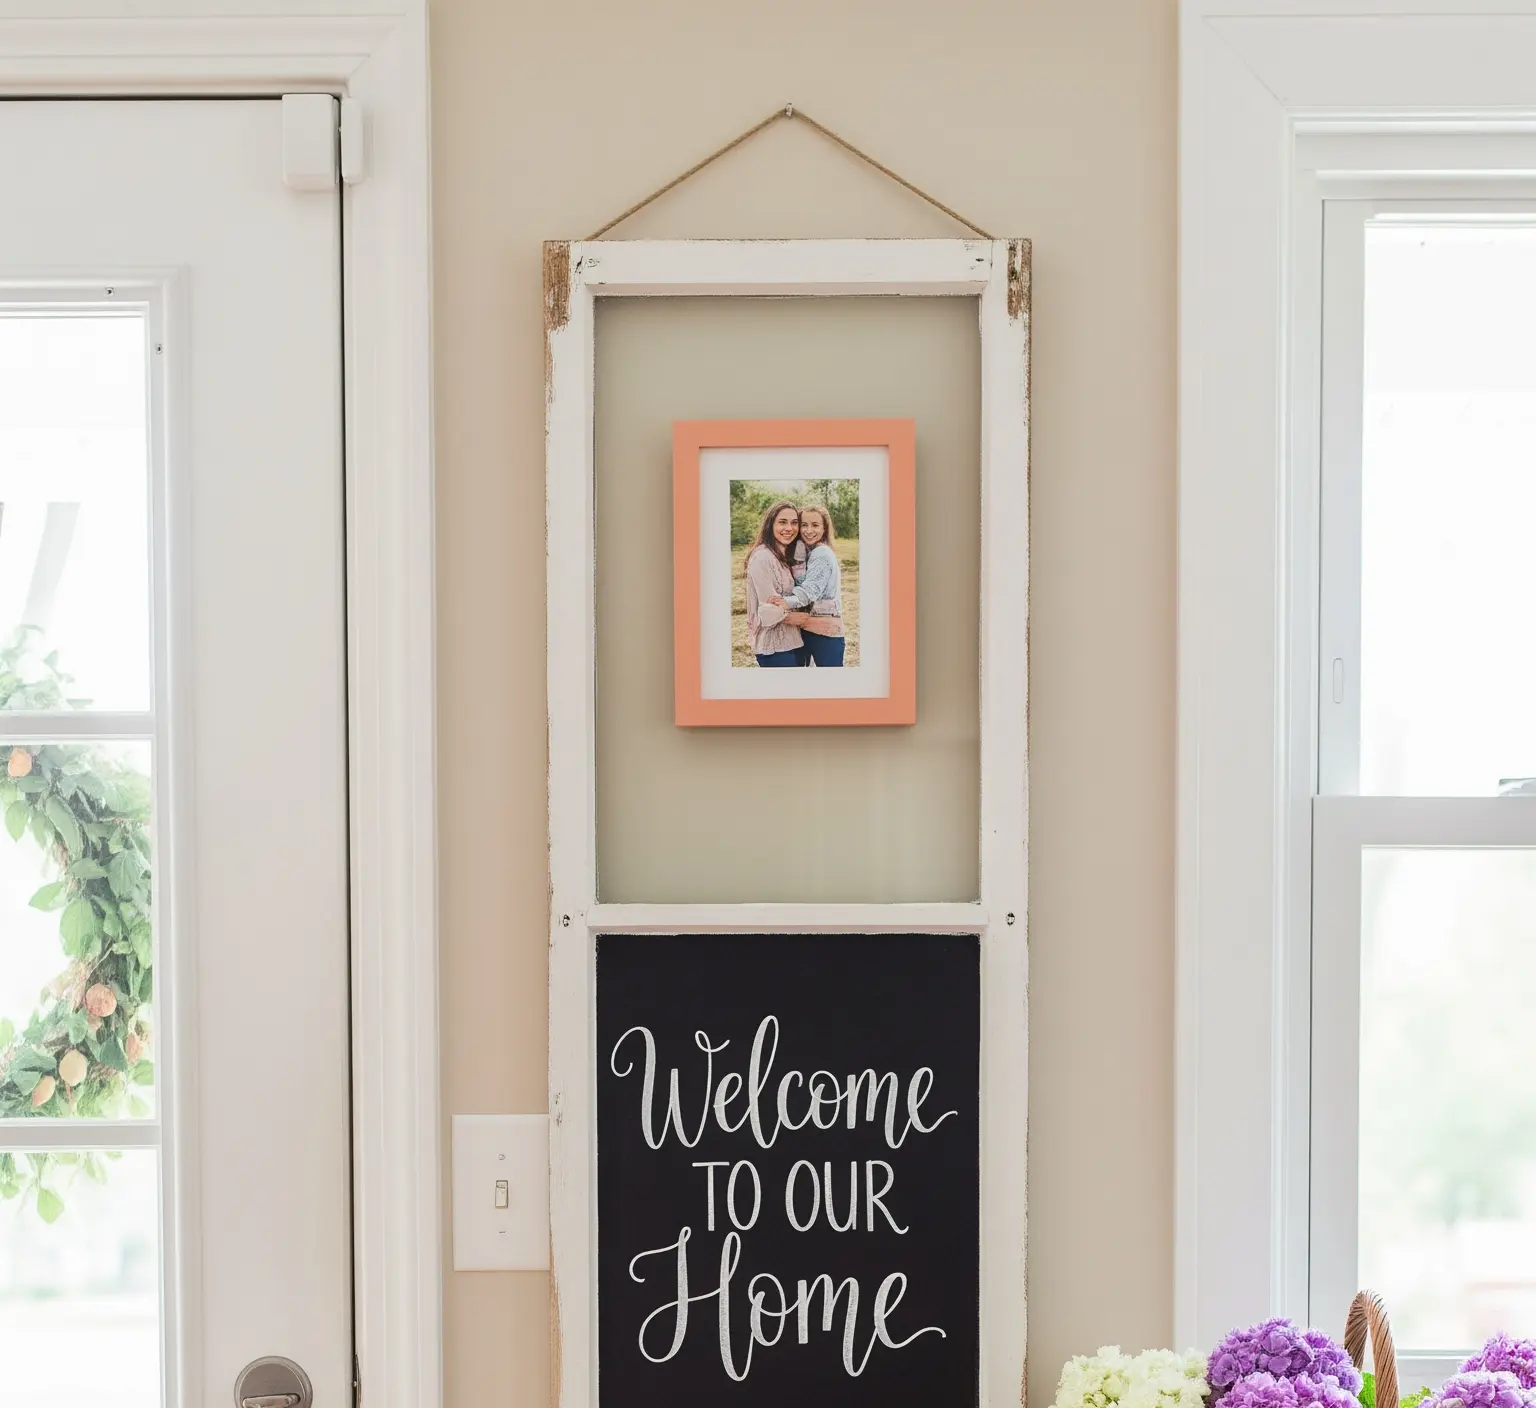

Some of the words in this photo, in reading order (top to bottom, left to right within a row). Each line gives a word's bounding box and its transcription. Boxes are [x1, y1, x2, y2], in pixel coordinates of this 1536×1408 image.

[611, 1015, 958, 1149] Welcome
[692, 1160, 761, 1231] TO
[786, 1160, 909, 1234] OUR
[629, 1226, 946, 1381] Home
